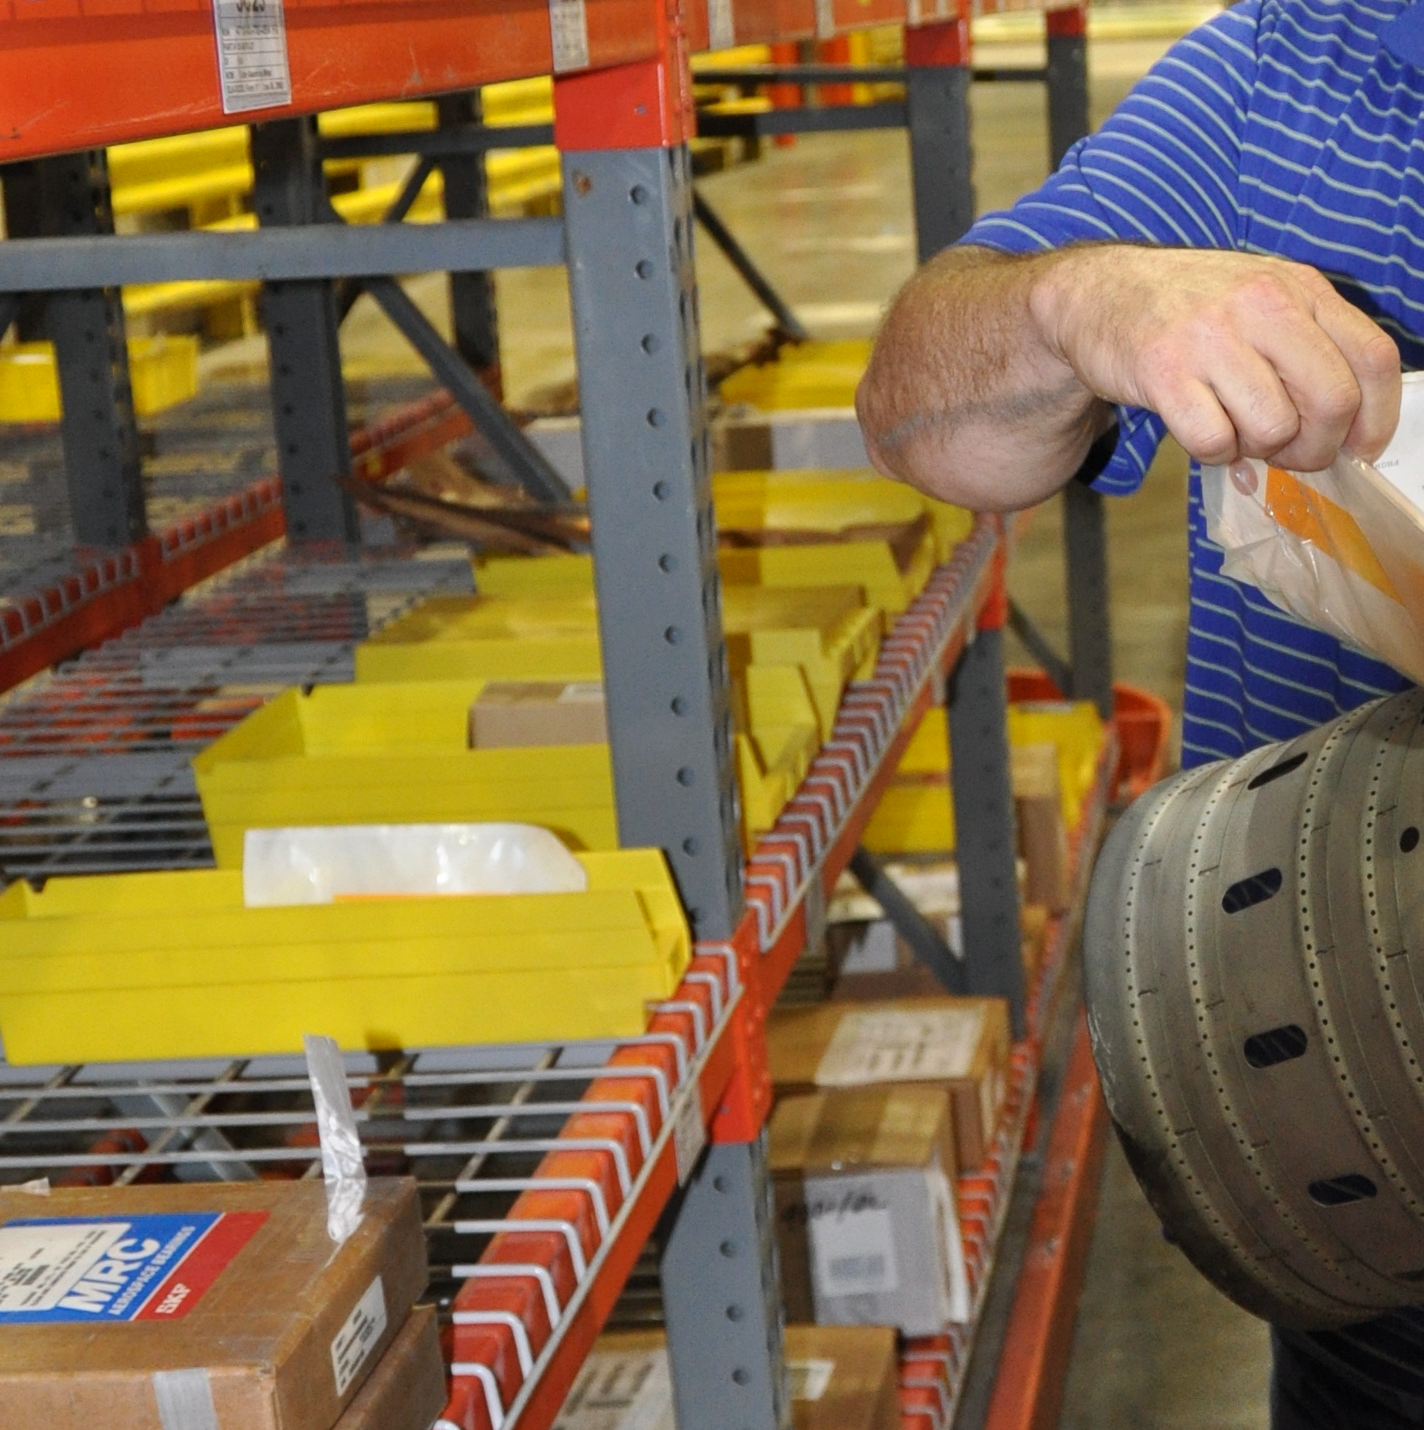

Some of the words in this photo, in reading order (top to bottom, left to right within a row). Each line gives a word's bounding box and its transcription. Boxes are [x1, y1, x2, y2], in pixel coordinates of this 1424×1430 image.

[56, 1237, 162, 1314] MRC
[108, 1263, 161, 1316] AEROSPACE
[151, 1224, 196, 1266] BEARINGS
[154, 1282, 192, 1315] SKF
